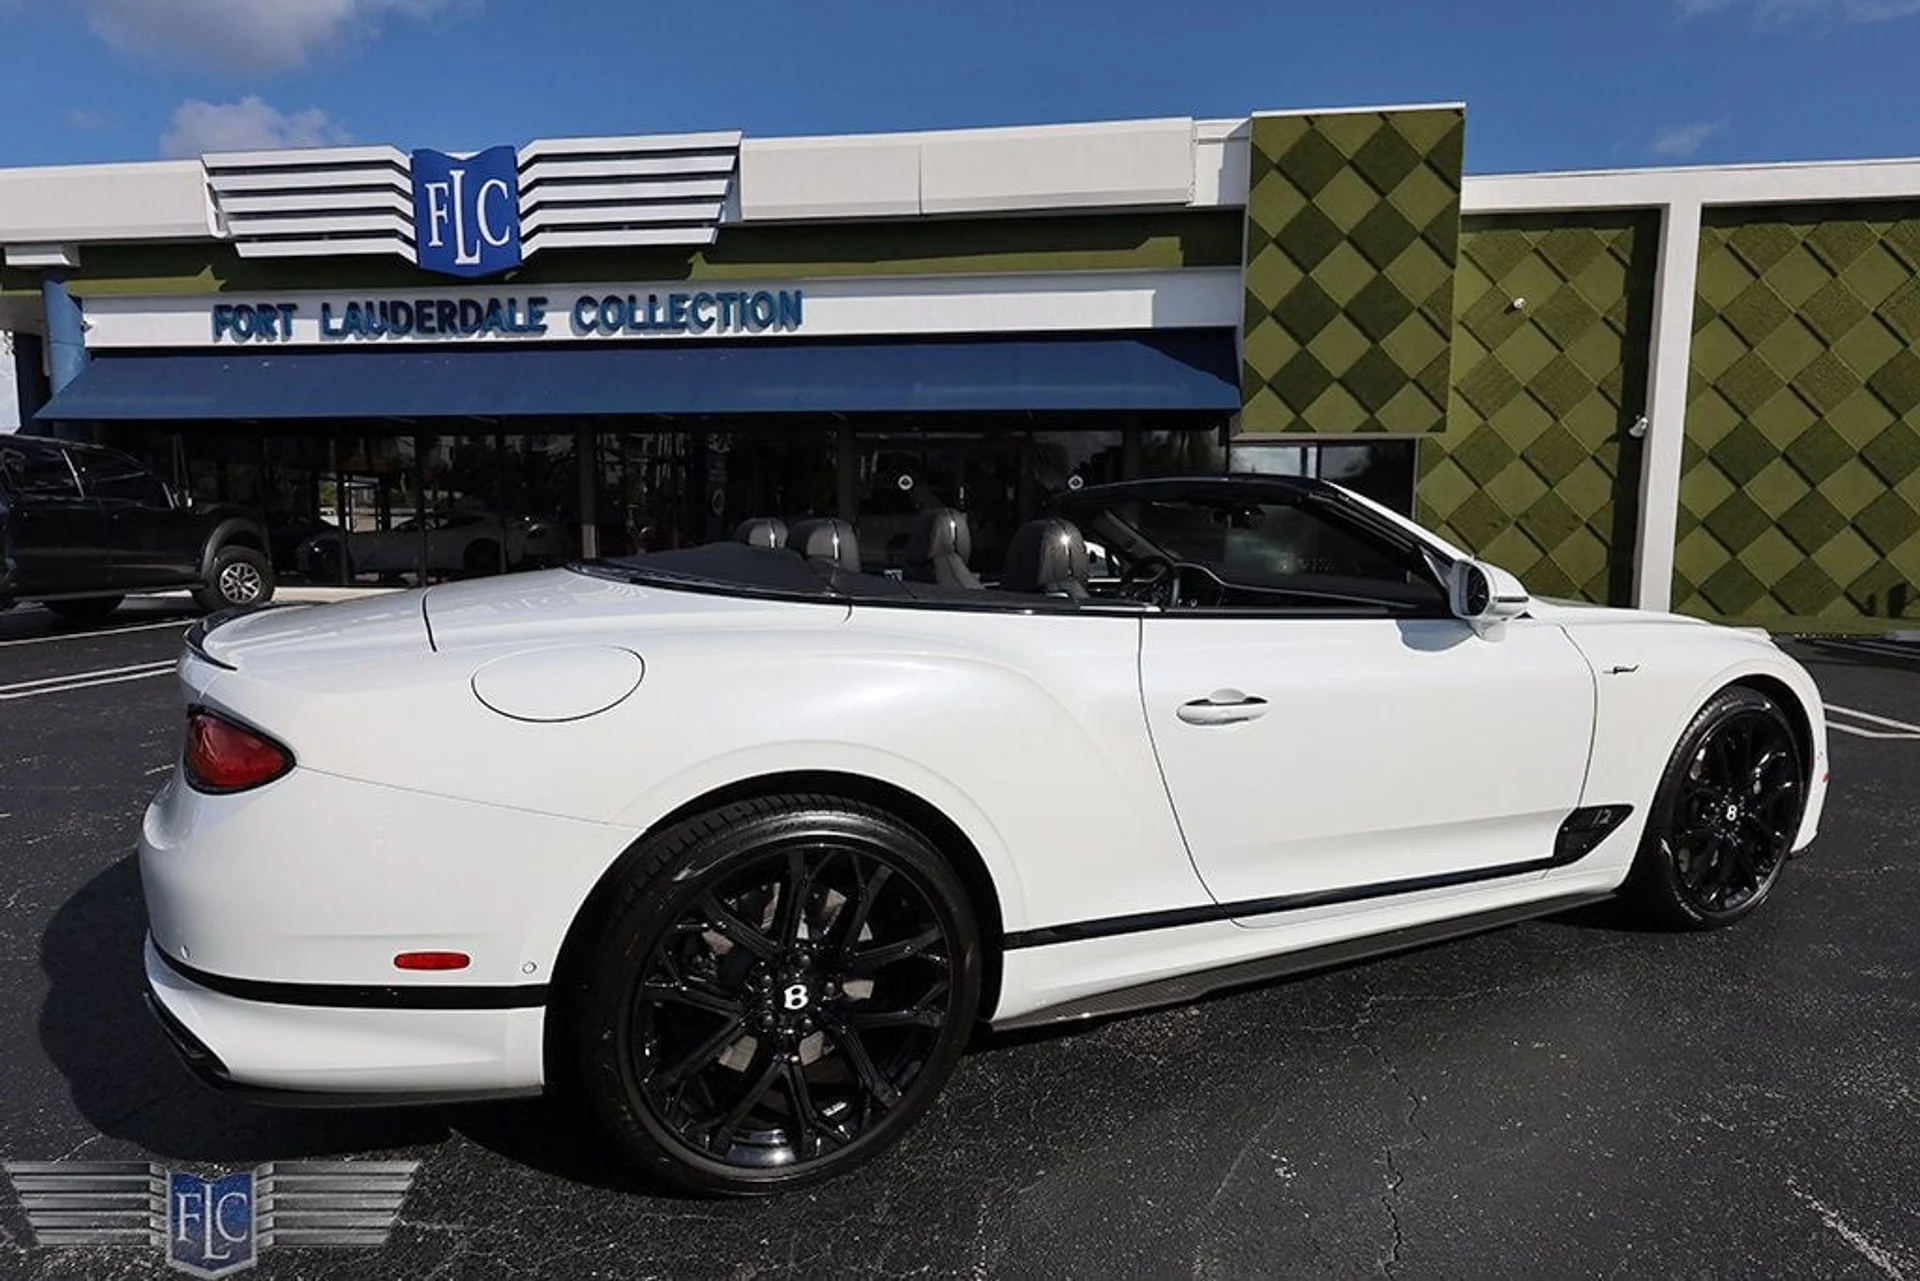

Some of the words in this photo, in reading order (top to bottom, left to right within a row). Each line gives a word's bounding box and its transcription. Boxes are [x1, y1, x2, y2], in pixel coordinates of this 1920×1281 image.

[425, 169, 511, 265] FLC
[212, 303, 297, 340] FORT
[320, 297, 548, 337] LAUDERDALE
[575, 291, 803, 333] COLLECTION
[783, 984, 809, 1010] B
